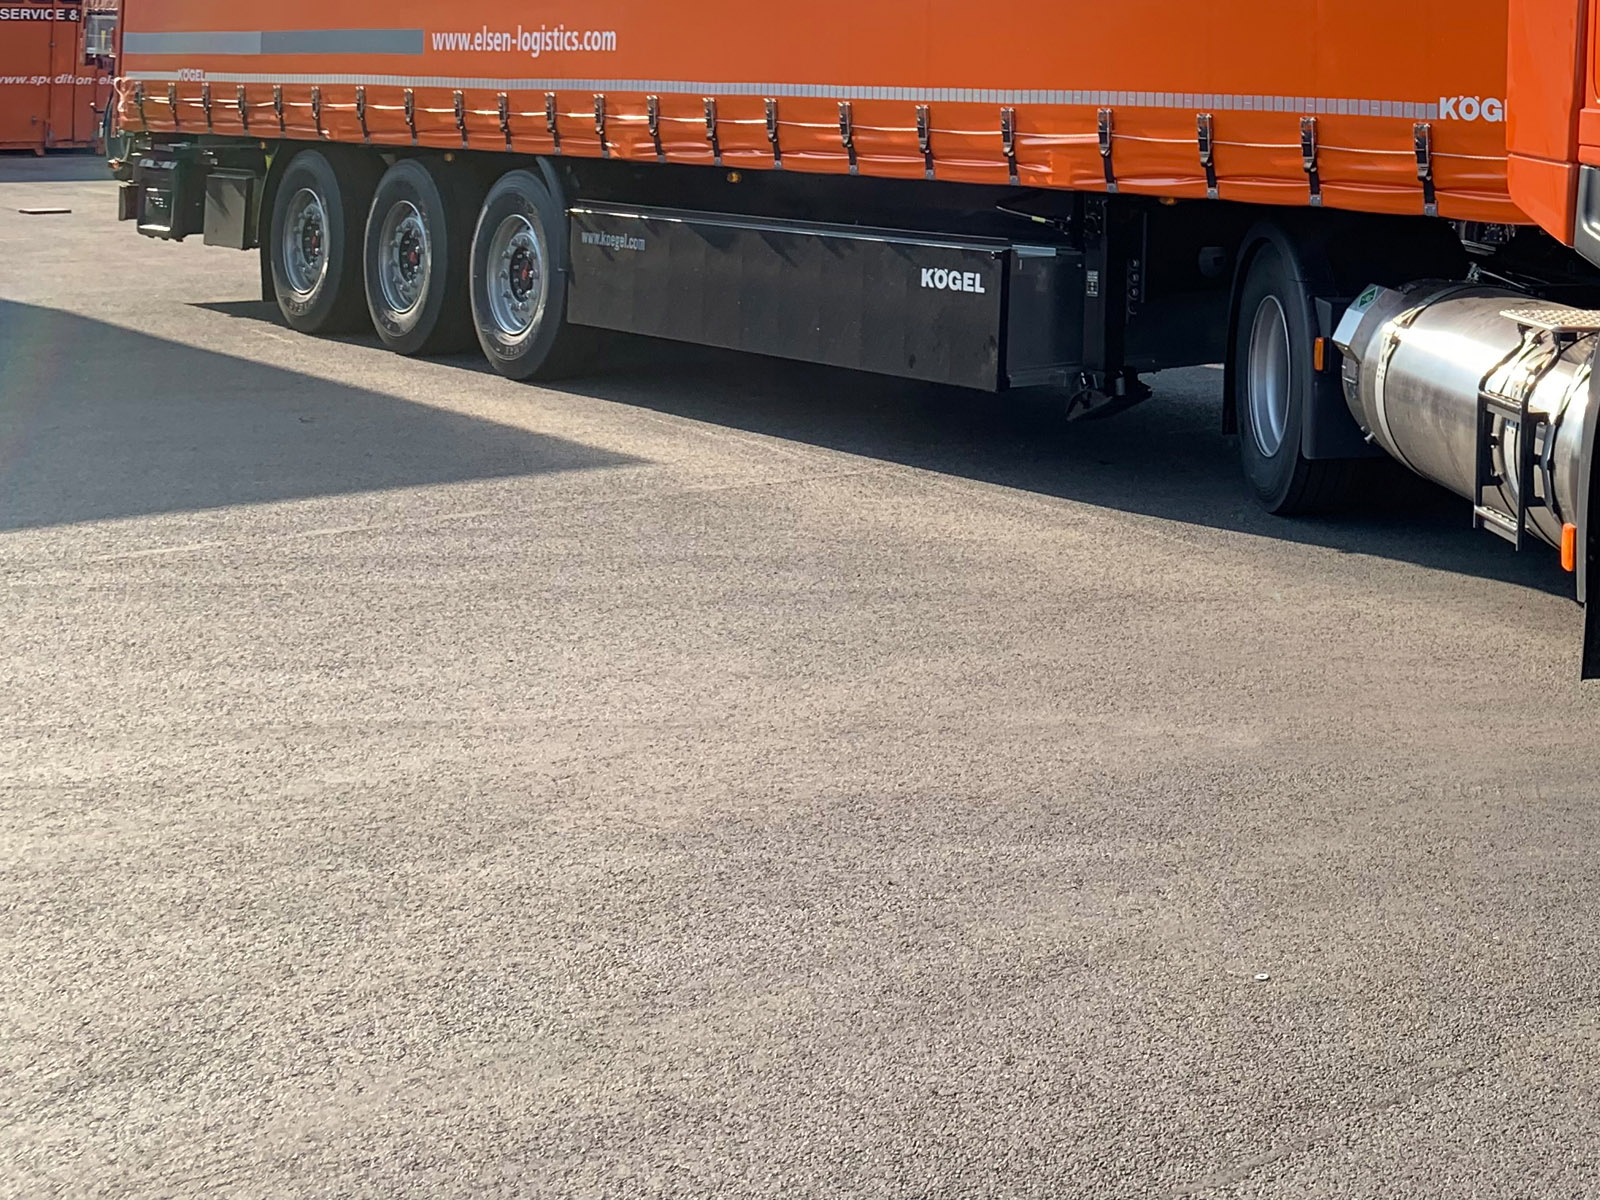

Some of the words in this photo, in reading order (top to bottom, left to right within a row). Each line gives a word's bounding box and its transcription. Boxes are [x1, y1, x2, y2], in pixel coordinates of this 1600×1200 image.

[0, 8, 65, 20] SERVICE
[432, 24, 617, 58] www.elsen-logistics.com
[1439, 95, 1508, 122] KÖG
[581, 231, 646, 251] www.koegel.com
[921, 268, 985, 293] KÖGEL
